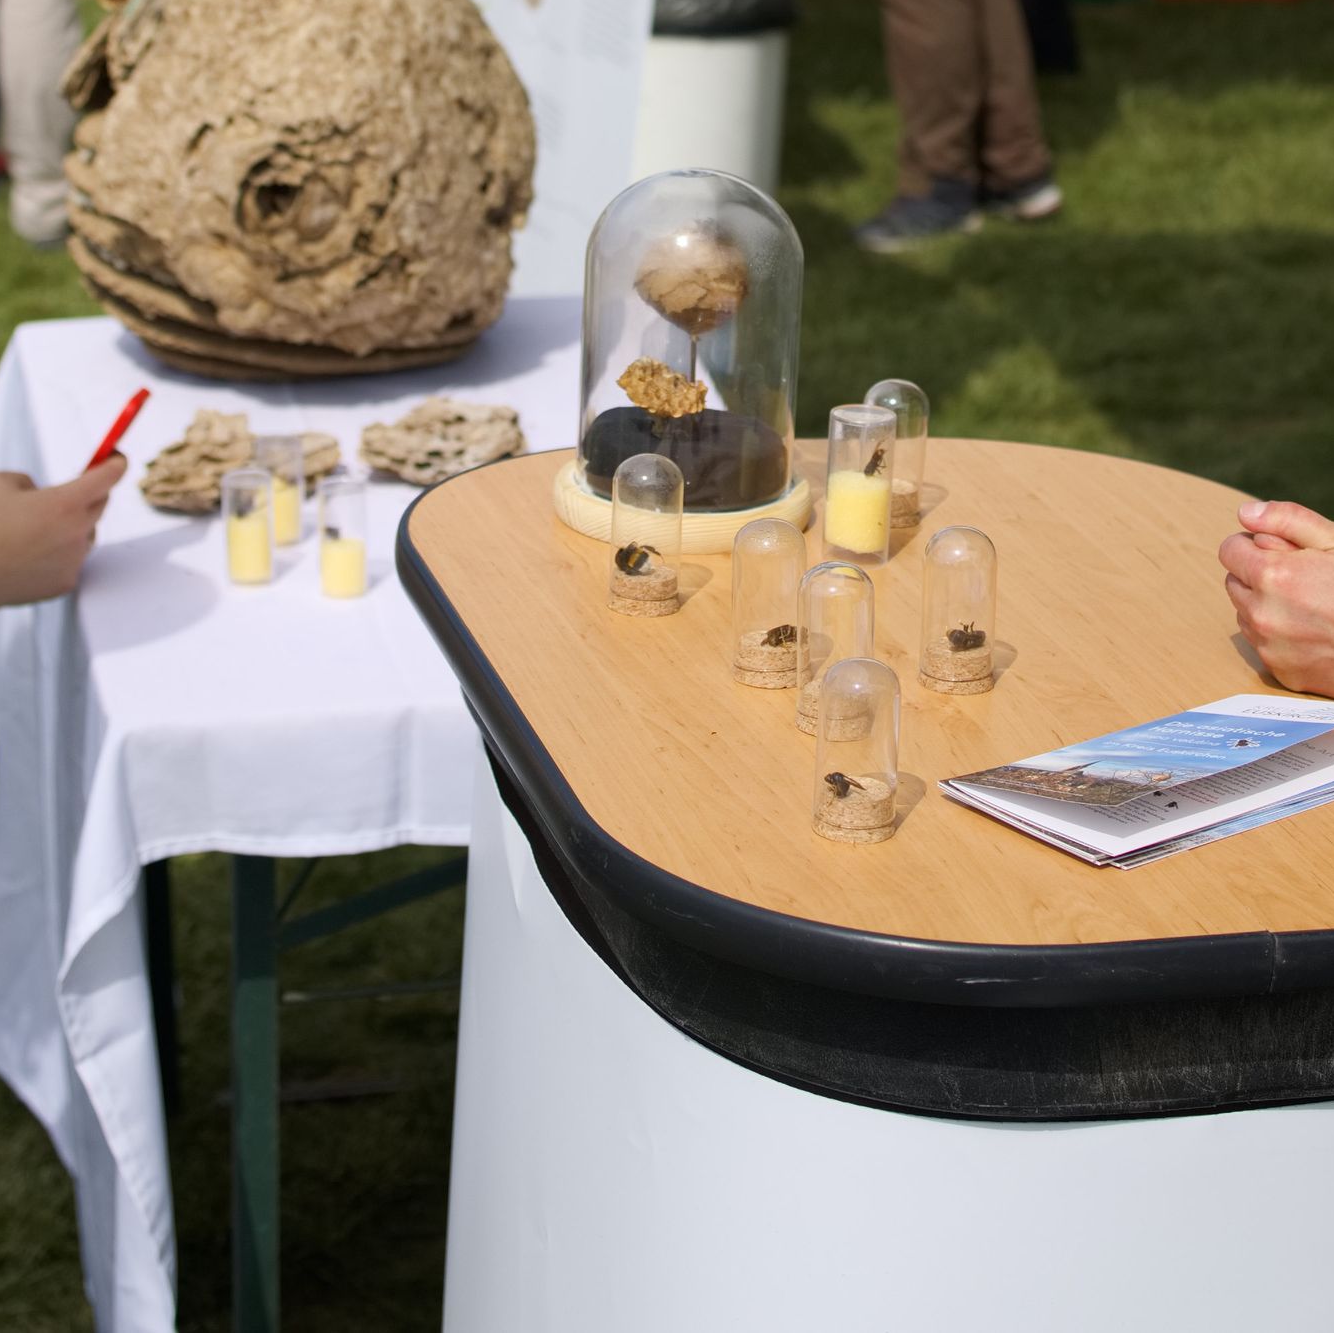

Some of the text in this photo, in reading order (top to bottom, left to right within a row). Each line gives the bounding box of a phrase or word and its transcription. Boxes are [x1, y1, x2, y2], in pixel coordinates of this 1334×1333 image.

[1149, 725, 1225, 739] Hornisse
[1166, 720, 1286, 738] Die asiatische
